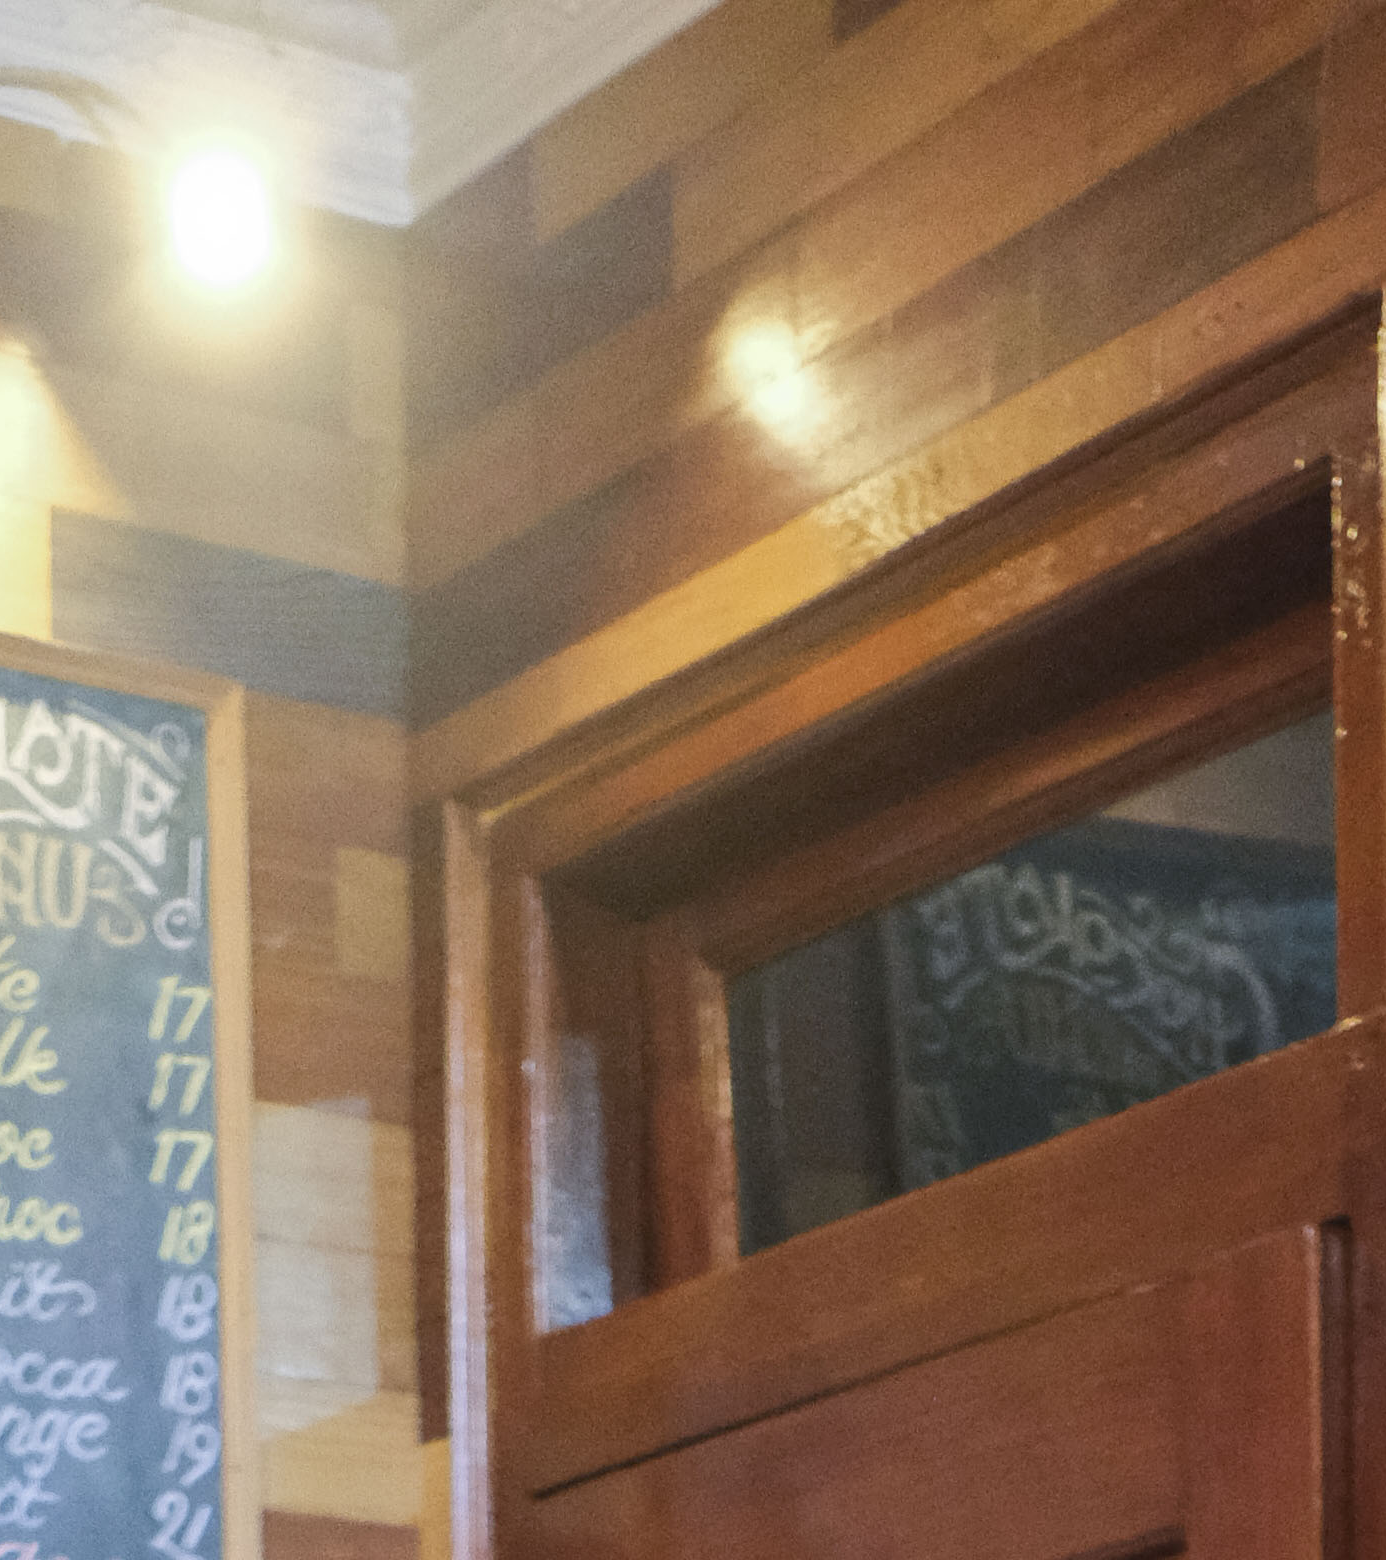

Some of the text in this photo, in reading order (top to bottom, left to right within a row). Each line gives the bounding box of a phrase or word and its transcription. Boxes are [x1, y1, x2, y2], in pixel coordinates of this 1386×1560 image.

[147, 974, 213, 1043] 17
[147, 1051, 213, 1115] 17
[148, 1129, 215, 1192] 17
[157, 1200, 215, 1265] 18
[157, 1273, 219, 1341] 18
[158, 1350, 218, 1415] 18
[161, 1418, 222, 1488] 19
